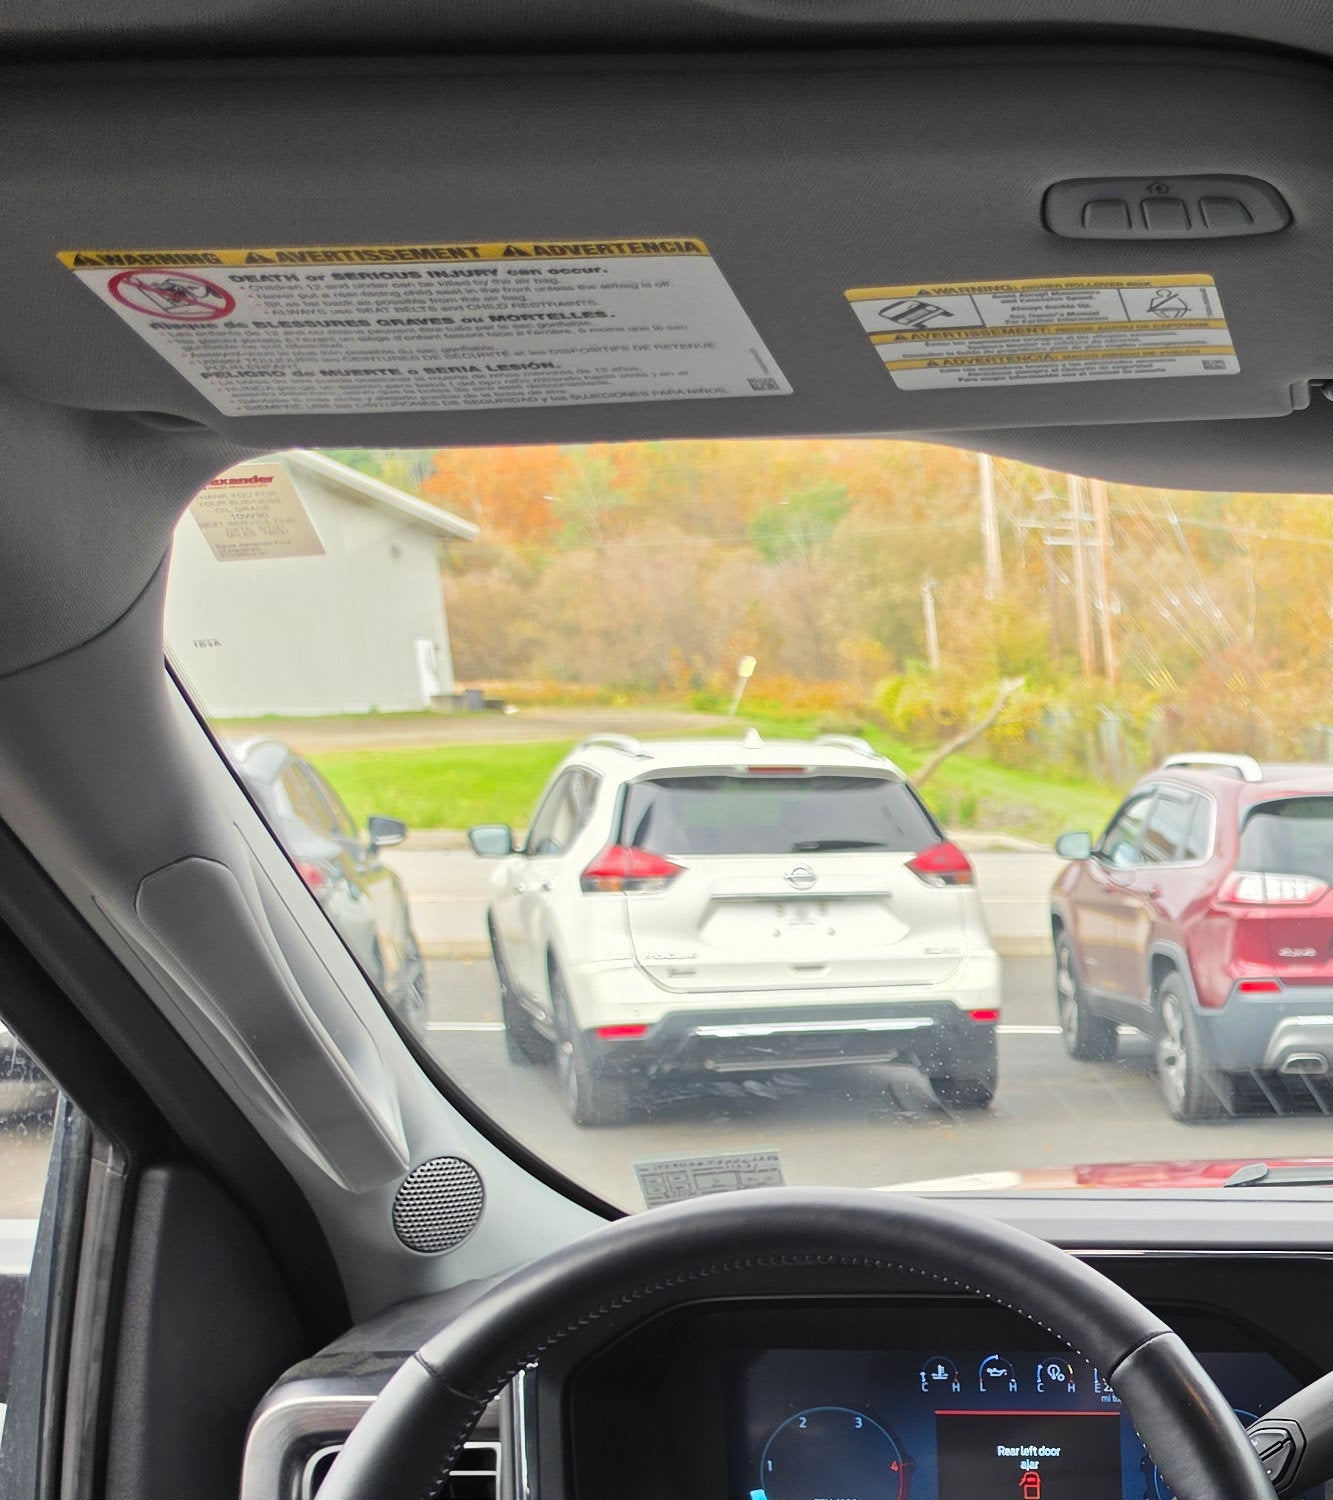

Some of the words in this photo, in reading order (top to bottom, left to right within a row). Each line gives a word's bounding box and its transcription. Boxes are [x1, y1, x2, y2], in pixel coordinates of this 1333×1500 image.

[100, 252, 219, 266] WARNING
[275, 246, 482, 264] AVERTISSEMENT
[533, 241, 703, 257] ADVERTENCIA
[229, 273, 301, 283] DEATH
[305, 274, 327, 282] or
[330, 271, 423, 281] SERIOUS
[426, 269, 499, 279] INJURY
[507, 268, 542, 276] can
[547, 266, 609, 275] occur.
[252, 319, 372, 329] BLESSURES
[377, 317, 455, 327] GRAVES
[921, 1382, 930, 1393] C
[951, 1382, 961, 1393] H
[979, 1382, 987, 1393] L
[1009, 1382, 1018, 1393] H
[1036, 1382, 1045, 1393] C
[1067, 1382, 1076, 1393] H
[799, 1416, 807, 1429] 2
[854, 1416, 863, 1429] 3
[997, 1445, 1020, 1457] Rear
[1021, 1445, 1038, 1457] left
[1038, 1445, 1061, 1457] door
[767, 1459, 773, 1472] 1
[889, 1460, 899, 1472] 4
[1020, 1459, 1040, 1471] ajar
